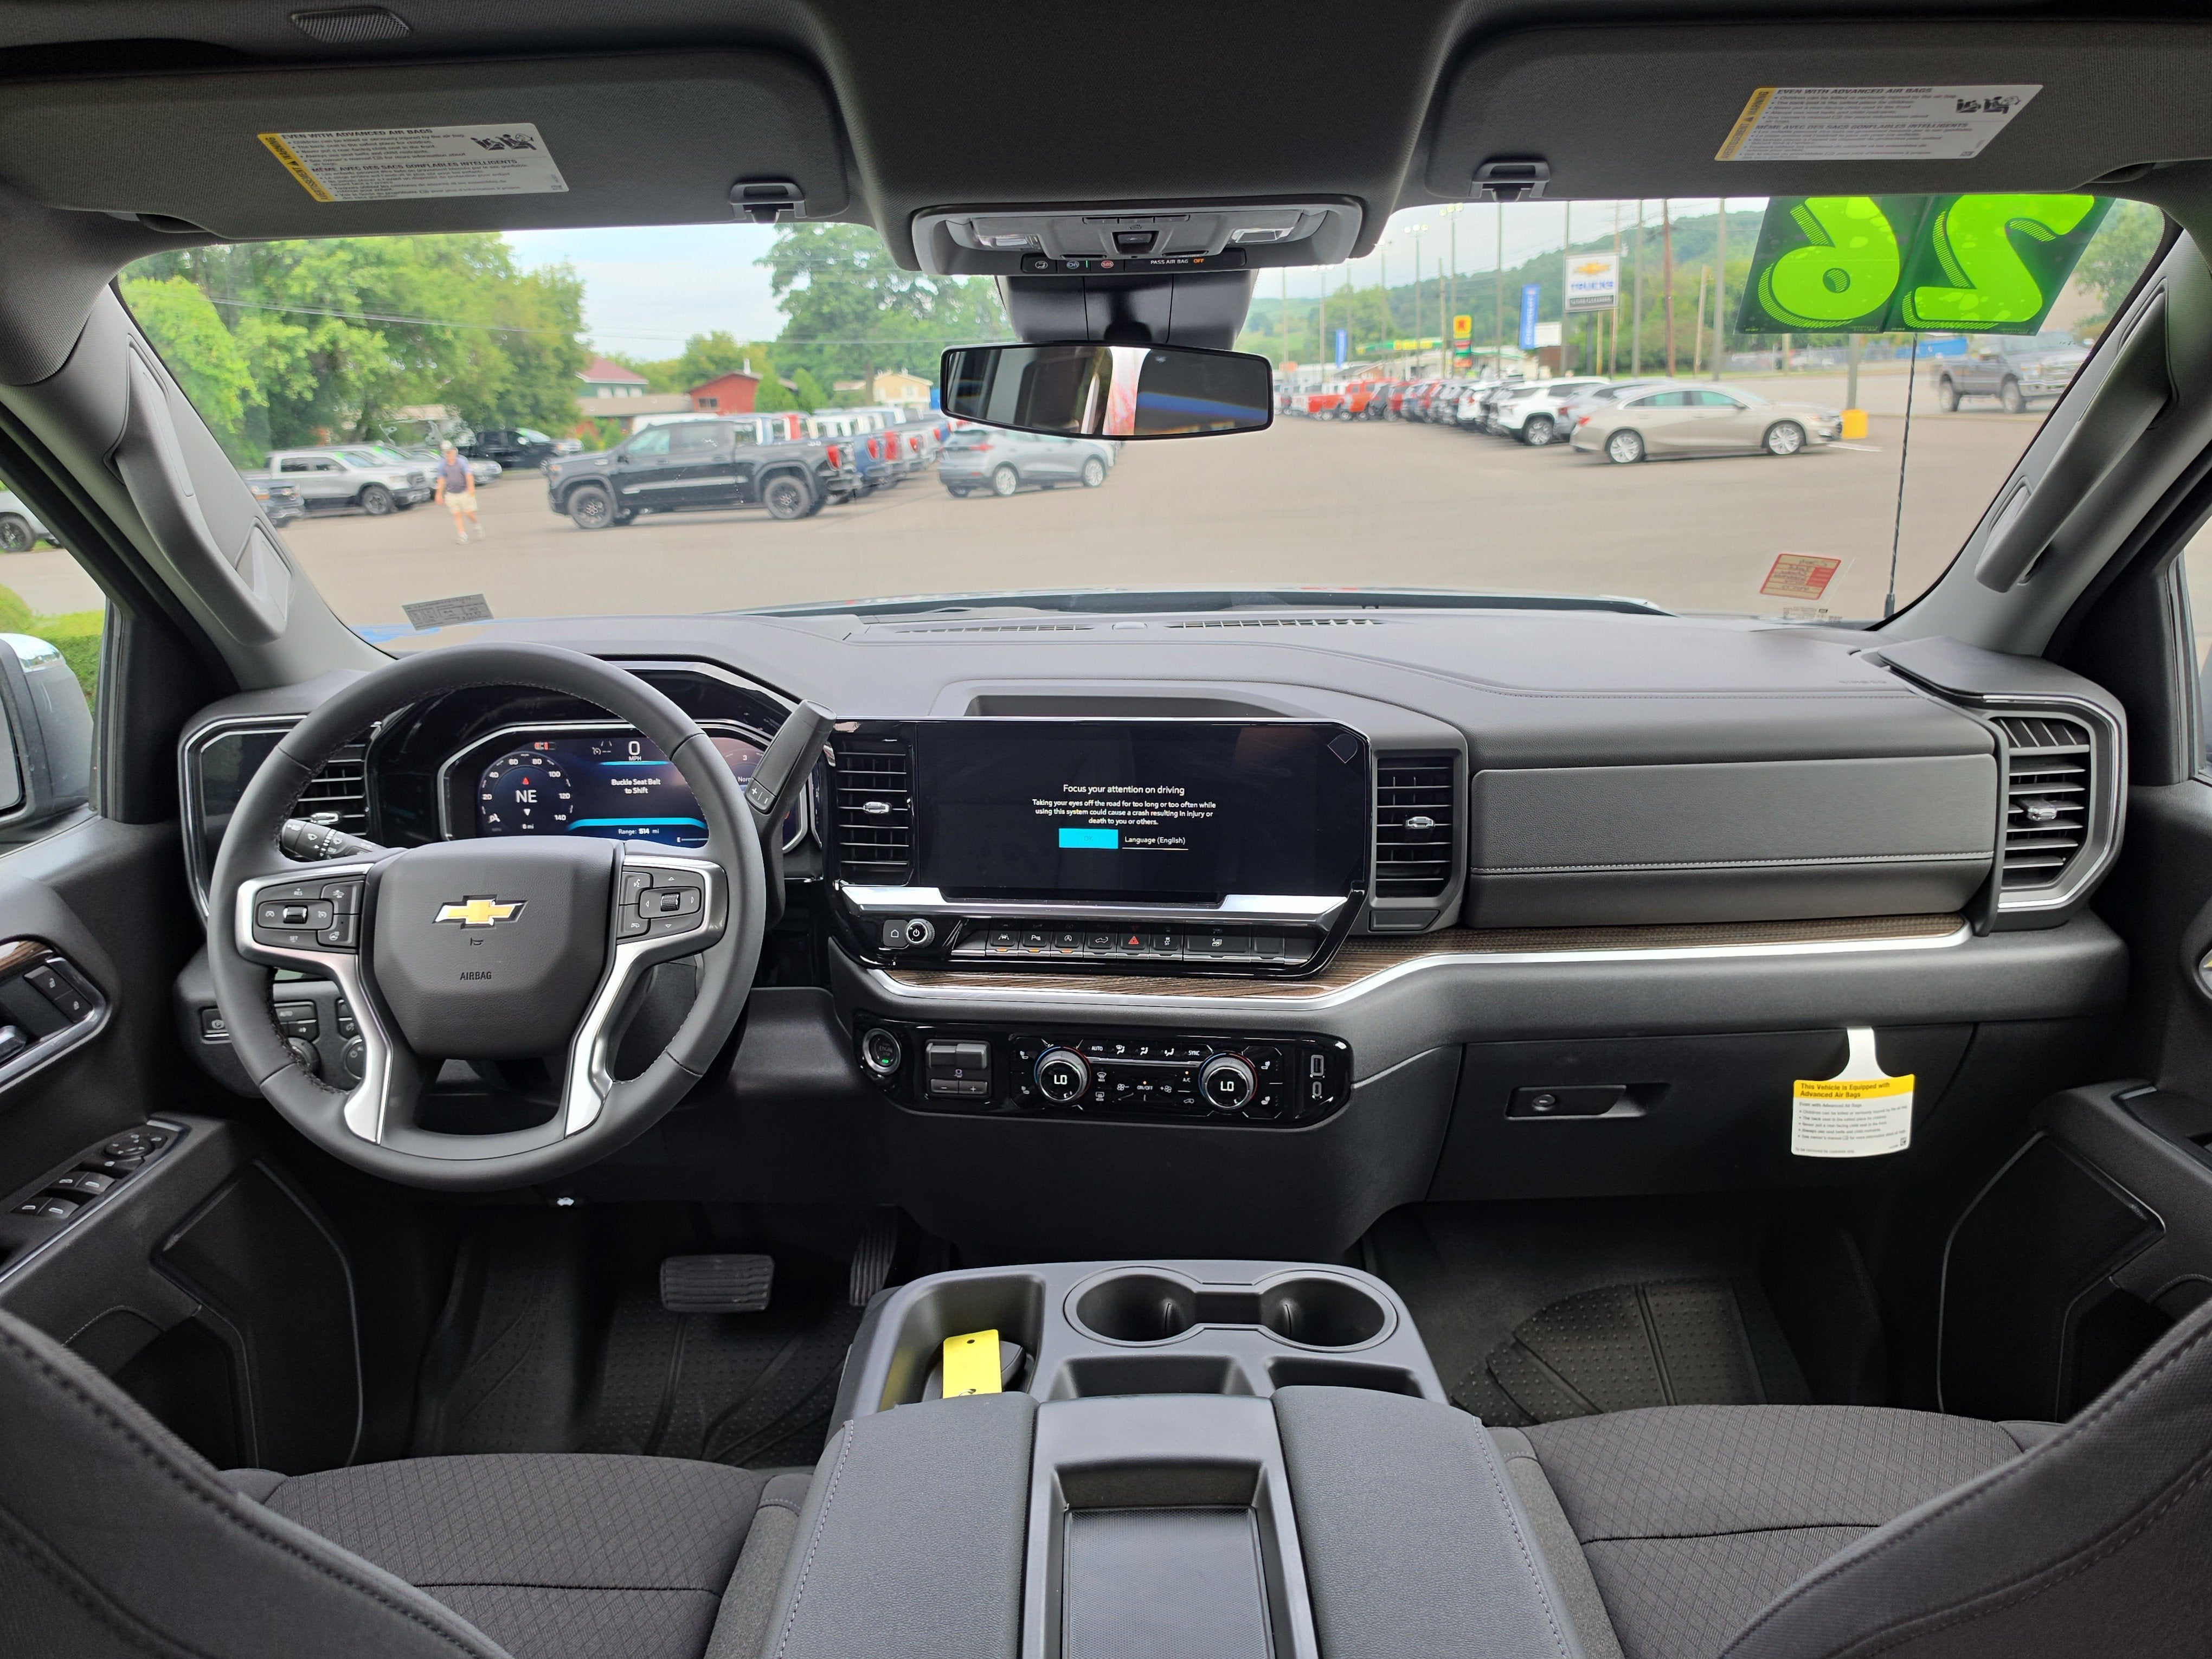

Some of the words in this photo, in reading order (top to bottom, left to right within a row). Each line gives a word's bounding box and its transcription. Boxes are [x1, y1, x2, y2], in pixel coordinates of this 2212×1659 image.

[629, 741, 640, 755] 0
[1088, 787, 1106, 795] your
[1157, 786, 1185, 796] driving
[516, 790, 538, 803] NE
[1144, 801, 1159, 809] long
[1150, 810, 1178, 818] resulting
[1124, 837, 1156, 845] Language
[1157, 837, 1186, 845] (English)
[460, 971, 492, 980] AIRBAG
[1053, 1074, 1068, 1085] LO
[1220, 1081, 1234, 1092] LO
[1849, 1083, 1877, 1092] Equipped
